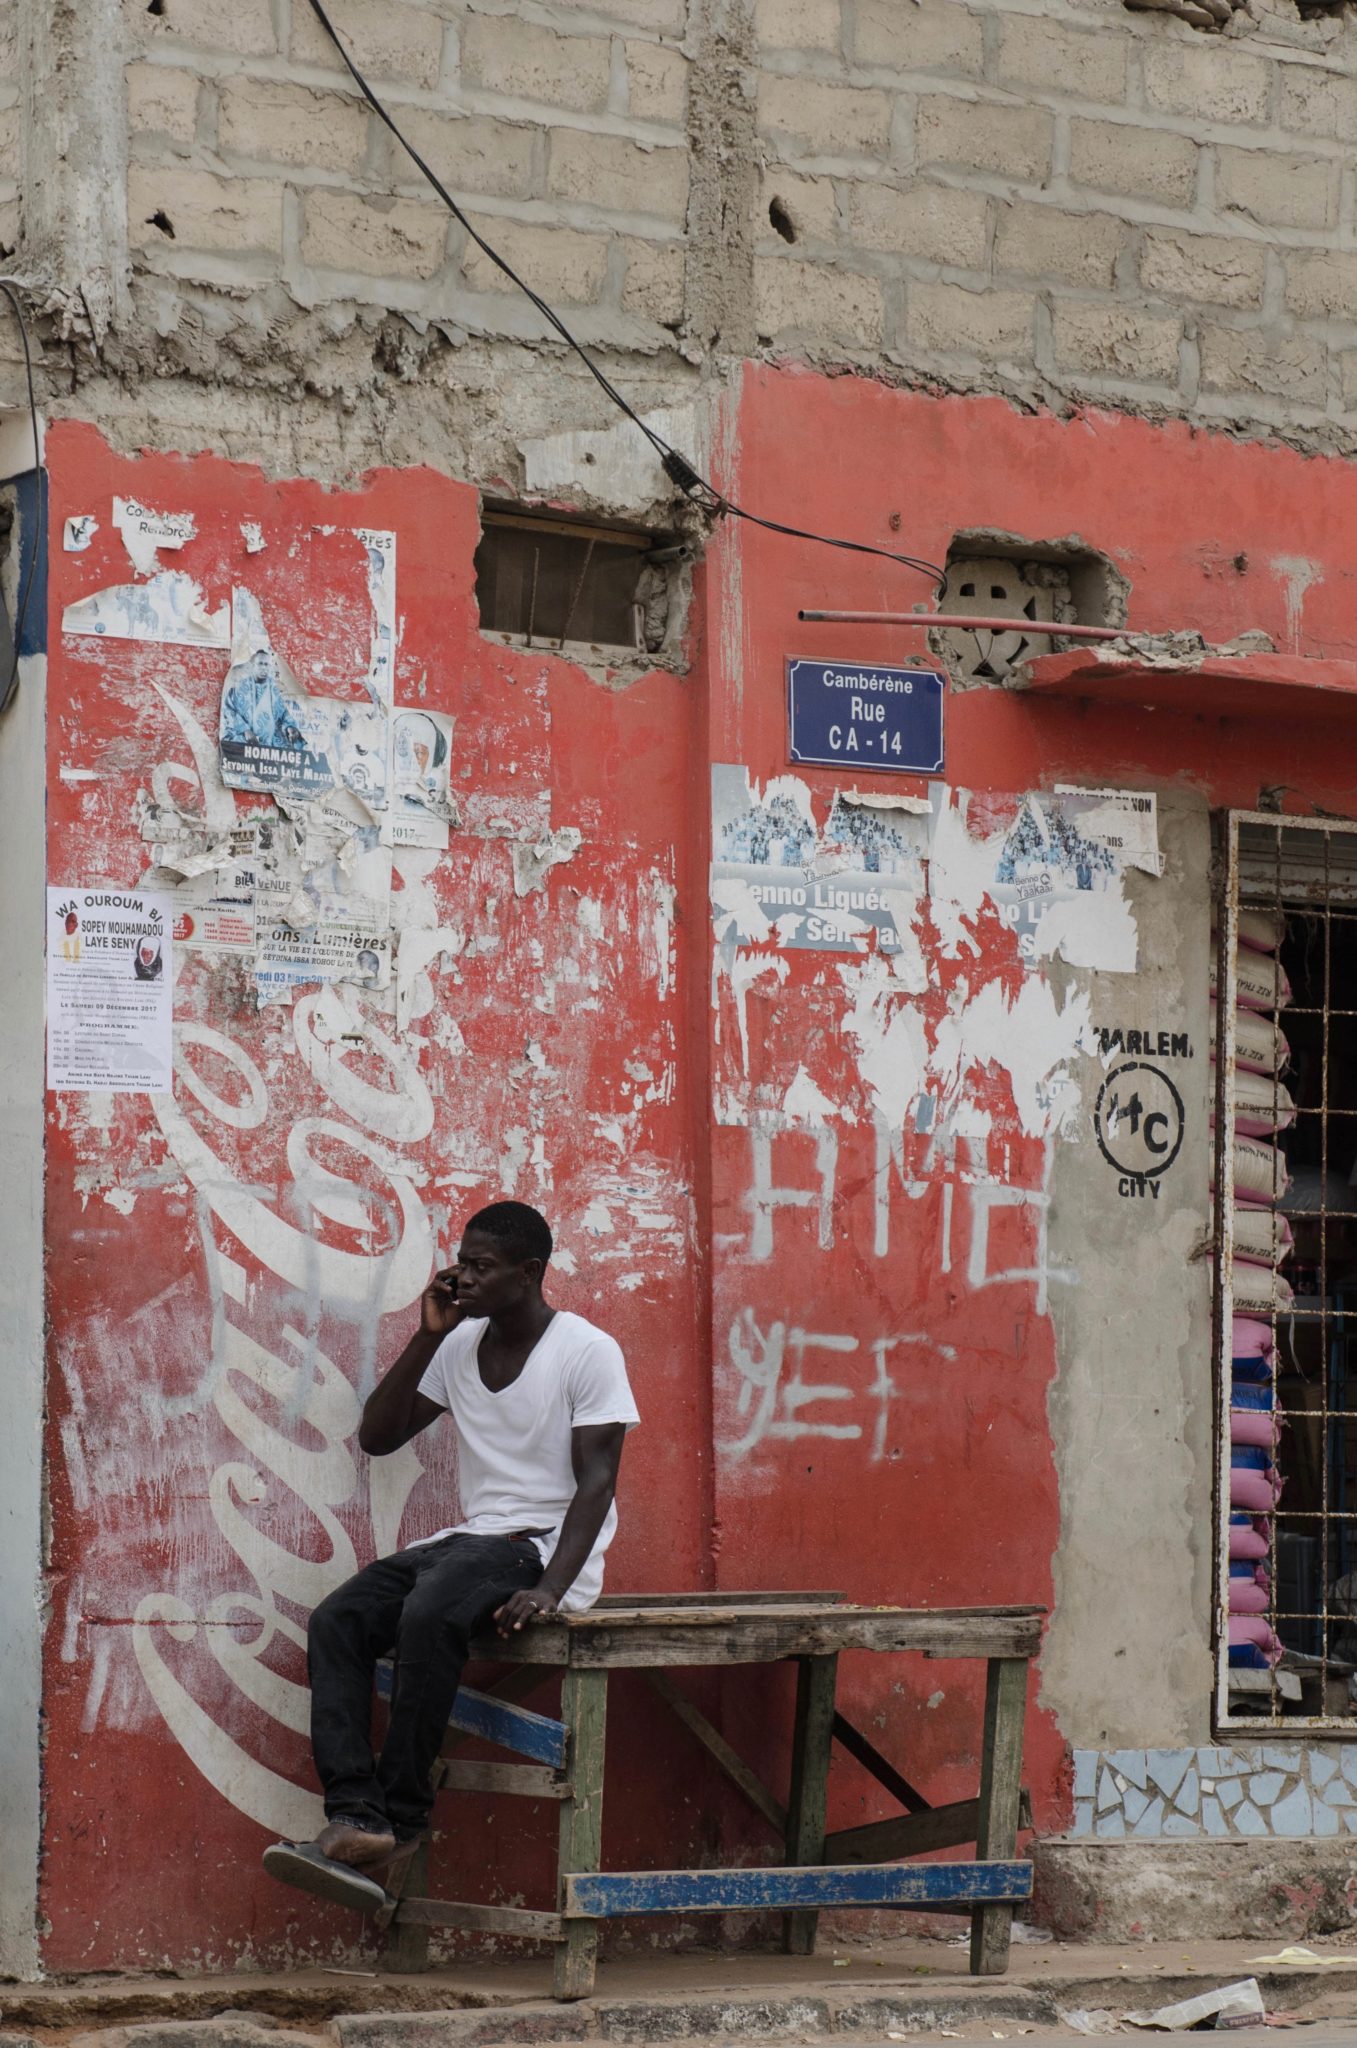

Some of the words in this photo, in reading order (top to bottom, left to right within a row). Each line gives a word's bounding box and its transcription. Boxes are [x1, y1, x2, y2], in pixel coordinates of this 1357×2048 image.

[823, 670, 913, 694] Cambérène
[851, 696, 885, 722] Rue
[880, 730, 901, 755] 14
[244, 745, 301, 764] HOMMAGE
[751, 884, 806, 906] enno
[55, 900, 78, 919] WA
[84, 895, 143, 912] OUROUM
[149, 908, 163, 922] BI
[81, 920, 107, 933] SOPEY
[108, 922, 163, 936] MOUHAMADOU
[85, 936, 109, 948] LAYE
[111, 938, 136, 949] SENY
[274, 972, 285, 982] 03
[1118, 1177, 1160, 1199] CITY
